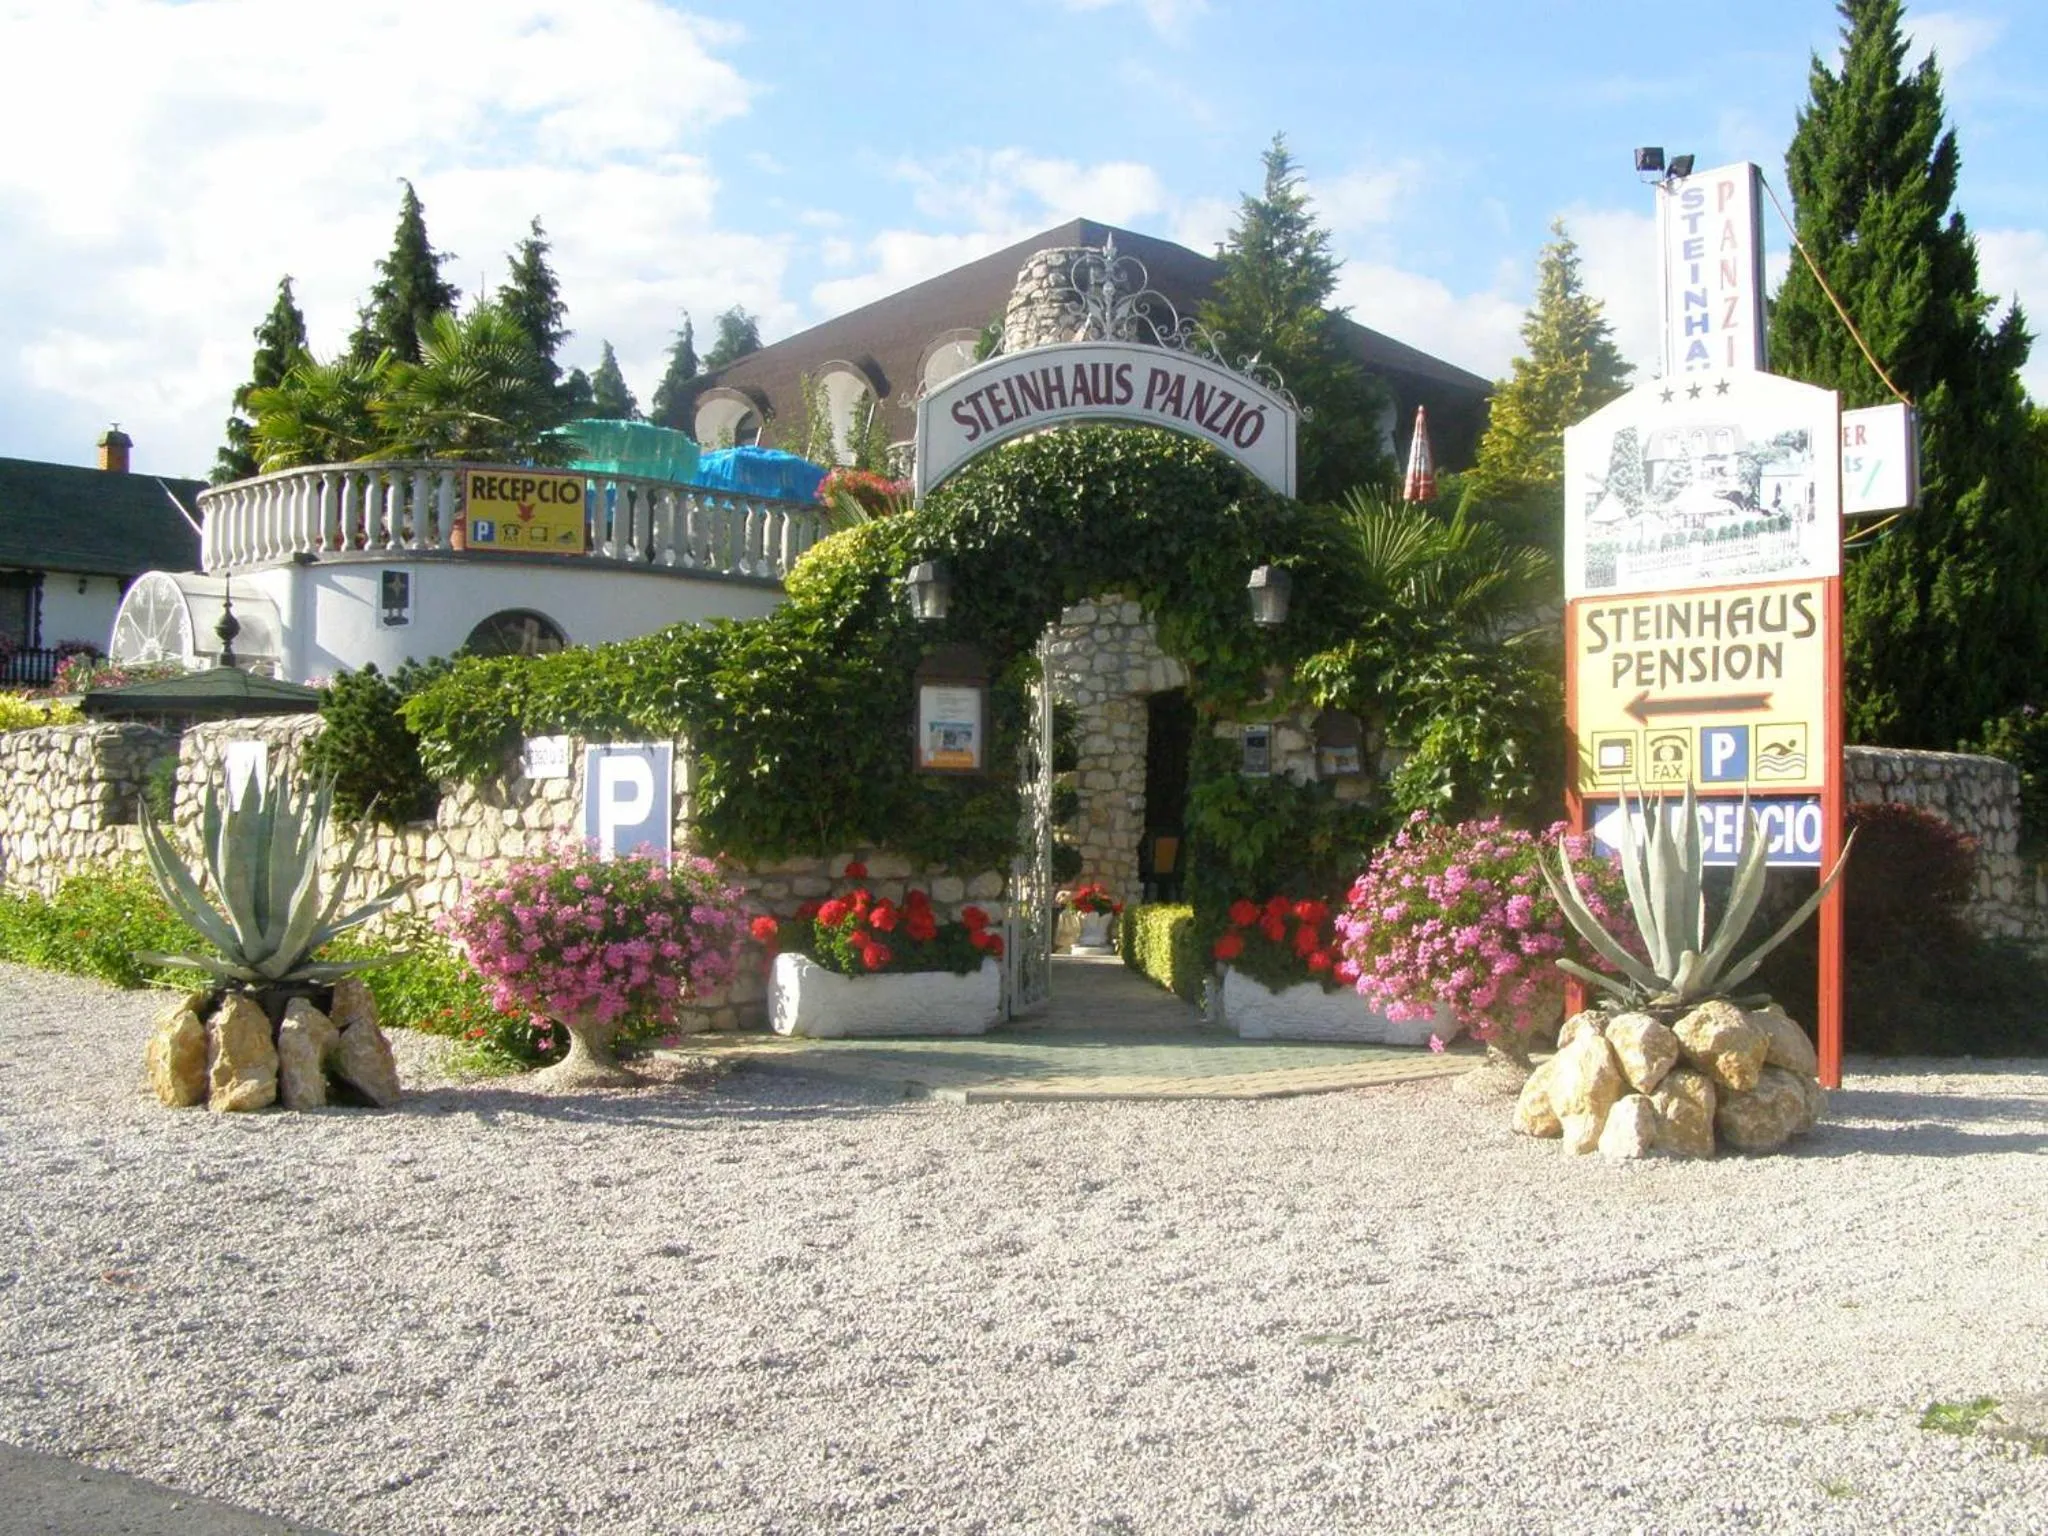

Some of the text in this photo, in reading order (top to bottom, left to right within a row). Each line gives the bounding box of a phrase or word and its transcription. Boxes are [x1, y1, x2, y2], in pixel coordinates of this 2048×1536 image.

[1681, 187, 1711, 371] STEINHA
[951, 362, 1268, 449] STEINHAUS PANZIÓ
[477, 520, 489, 541] P
[1586, 592, 1817, 654] STEINHAUS
[1612, 642, 1784, 690] PENSION
[1653, 764, 1683, 780] FAX
[1711, 732, 1736, 776] P
[600, 755, 654, 863] P
